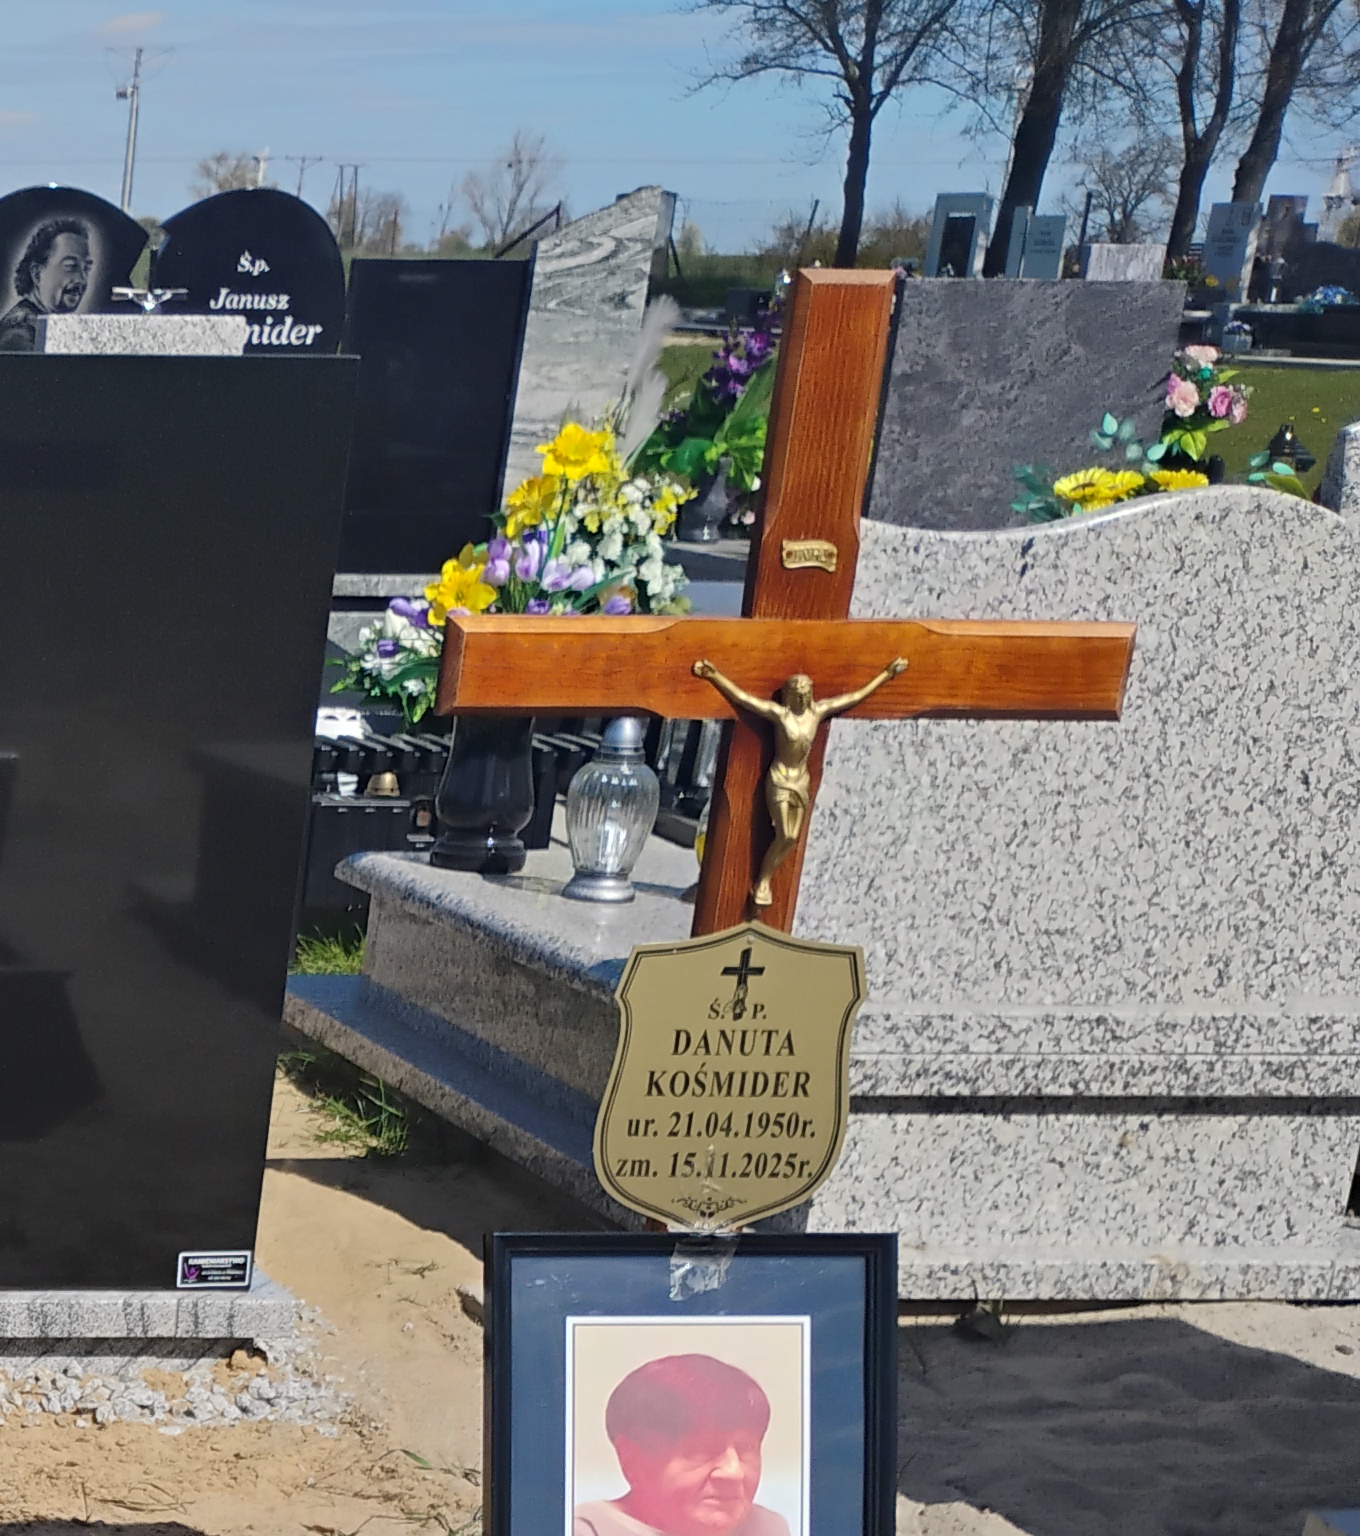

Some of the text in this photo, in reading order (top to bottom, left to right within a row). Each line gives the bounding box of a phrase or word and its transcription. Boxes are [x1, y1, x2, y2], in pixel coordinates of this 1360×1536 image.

[209, 287, 290, 310] Janusz
[708, 997, 767, 1020] Ś. P.
[671, 1028, 796, 1057] DANUTA
[644, 1062, 811, 1099] KOŚMIDER
[627, 1111, 816, 1138] ur. 21.04.1950r.
[615, 1151, 814, 1179] zm. 15.11.2025r.
